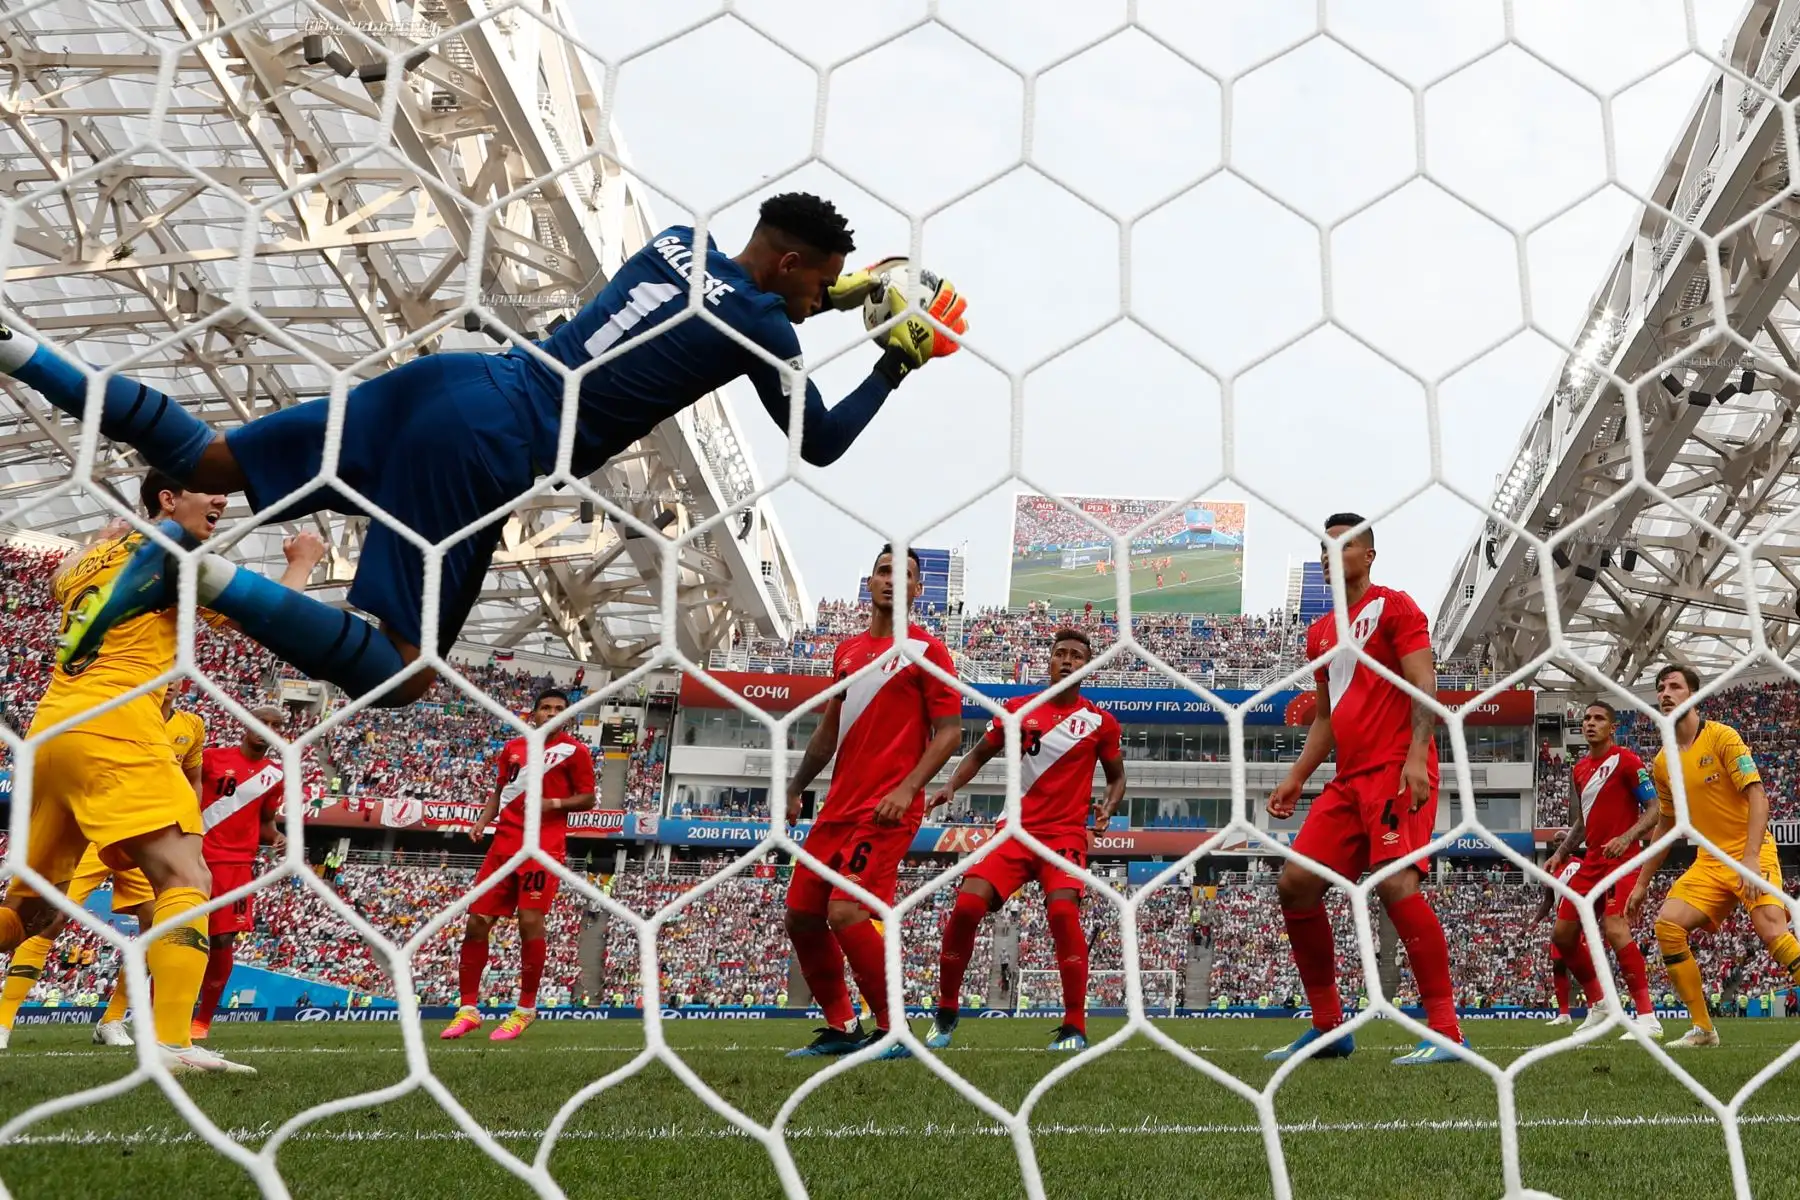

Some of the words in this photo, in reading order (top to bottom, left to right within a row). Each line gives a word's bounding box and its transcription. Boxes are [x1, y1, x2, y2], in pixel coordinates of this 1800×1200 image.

[583, 281, 682, 358] 1
[1087, 503, 1104, 512] PER
[743, 684, 790, 699] СОЧИ
[1155, 701, 1181, 712] FIFA
[1183, 702, 1211, 712] 2018
[216, 776, 237, 797] 18
[1381, 799, 1399, 831] 4
[687, 826, 720, 840] 2018
[722, 827, 752, 840] FIFA
[1093, 837, 1135, 849] SOCHI
[848, 841, 872, 873] 6
[523, 870, 546, 892] 20
[334, 1010, 422, 1021] HYUNDI
[537, 1010, 609, 1020] TUCSON
[1496, 1011, 1557, 1020] TUCSON
